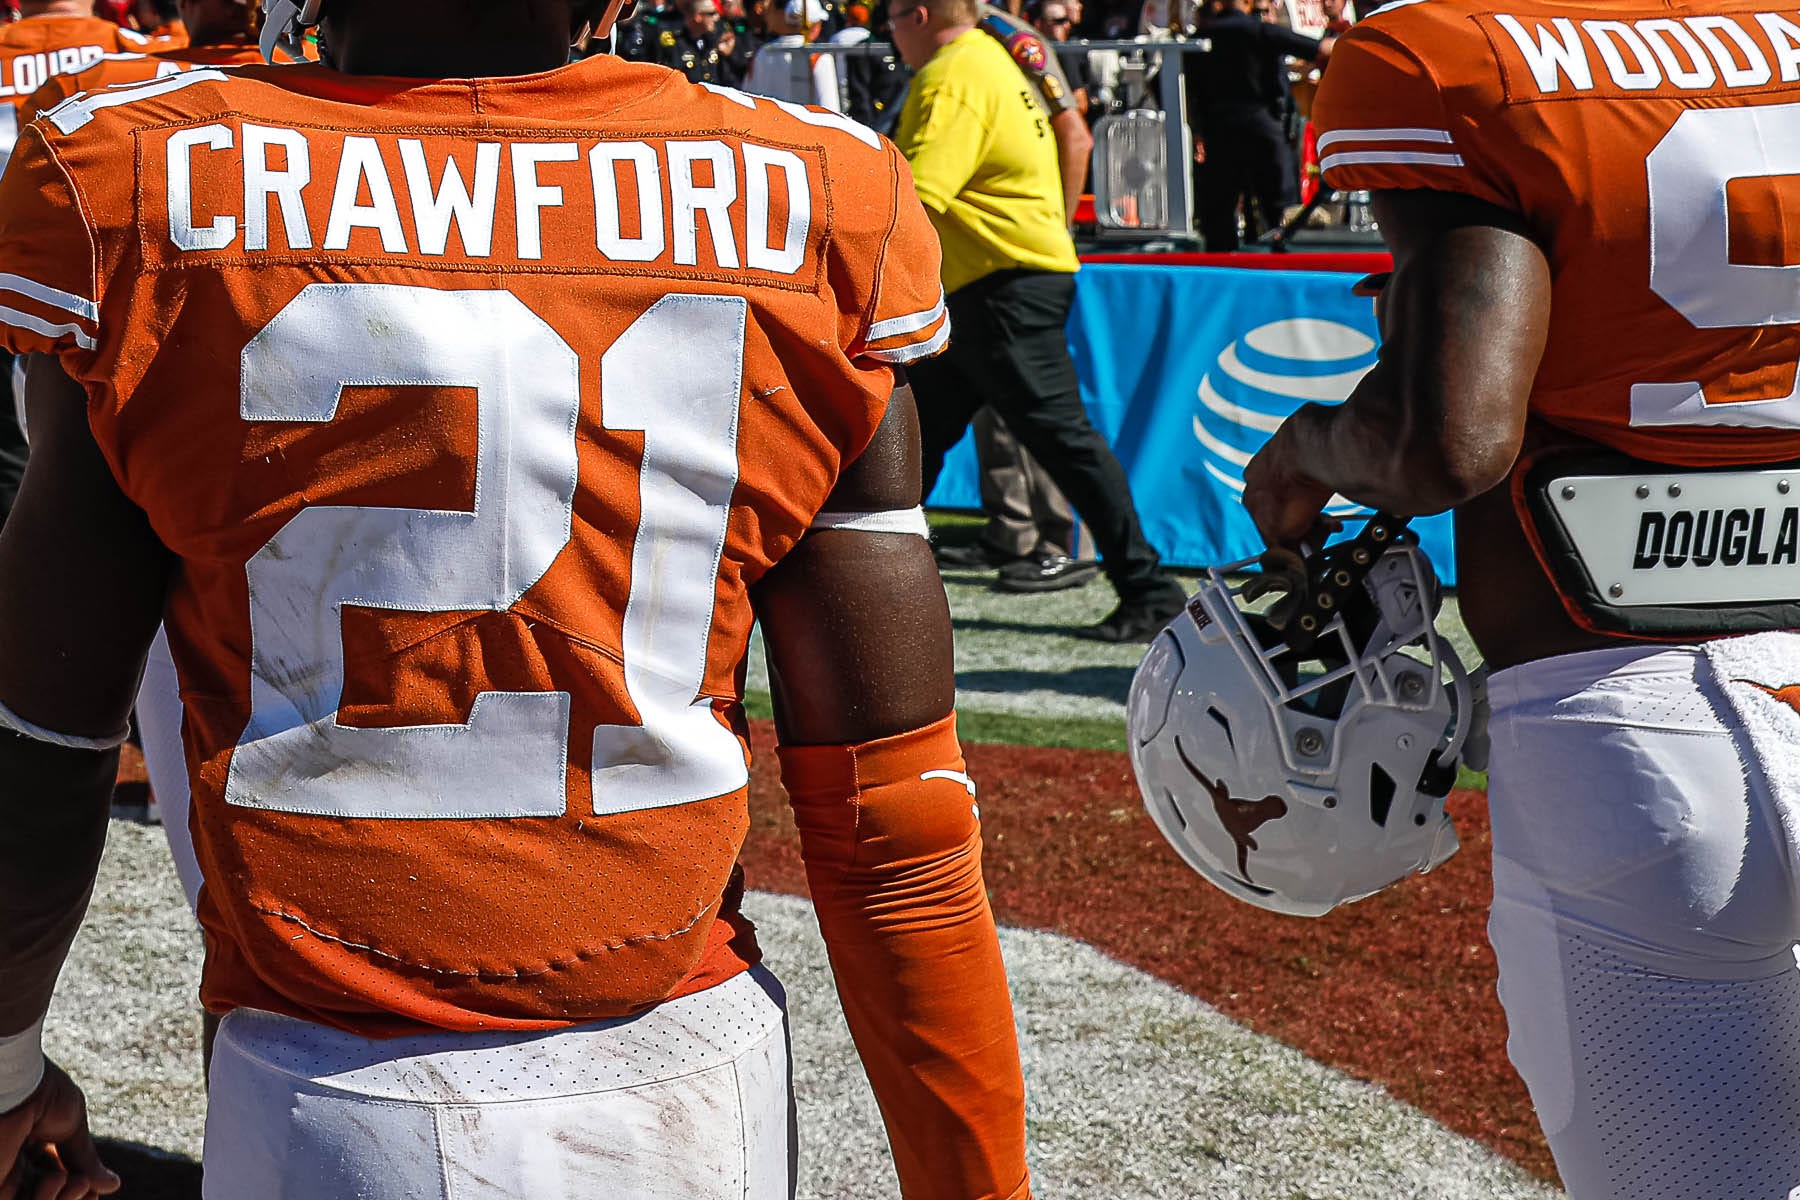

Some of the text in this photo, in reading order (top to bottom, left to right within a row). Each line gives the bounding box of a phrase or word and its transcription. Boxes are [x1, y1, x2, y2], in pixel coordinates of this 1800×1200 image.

[165, 123, 810, 276] CRAWFORD
[224, 283, 750, 820] 21
[1633, 506, 1800, 570] DOUGLA
